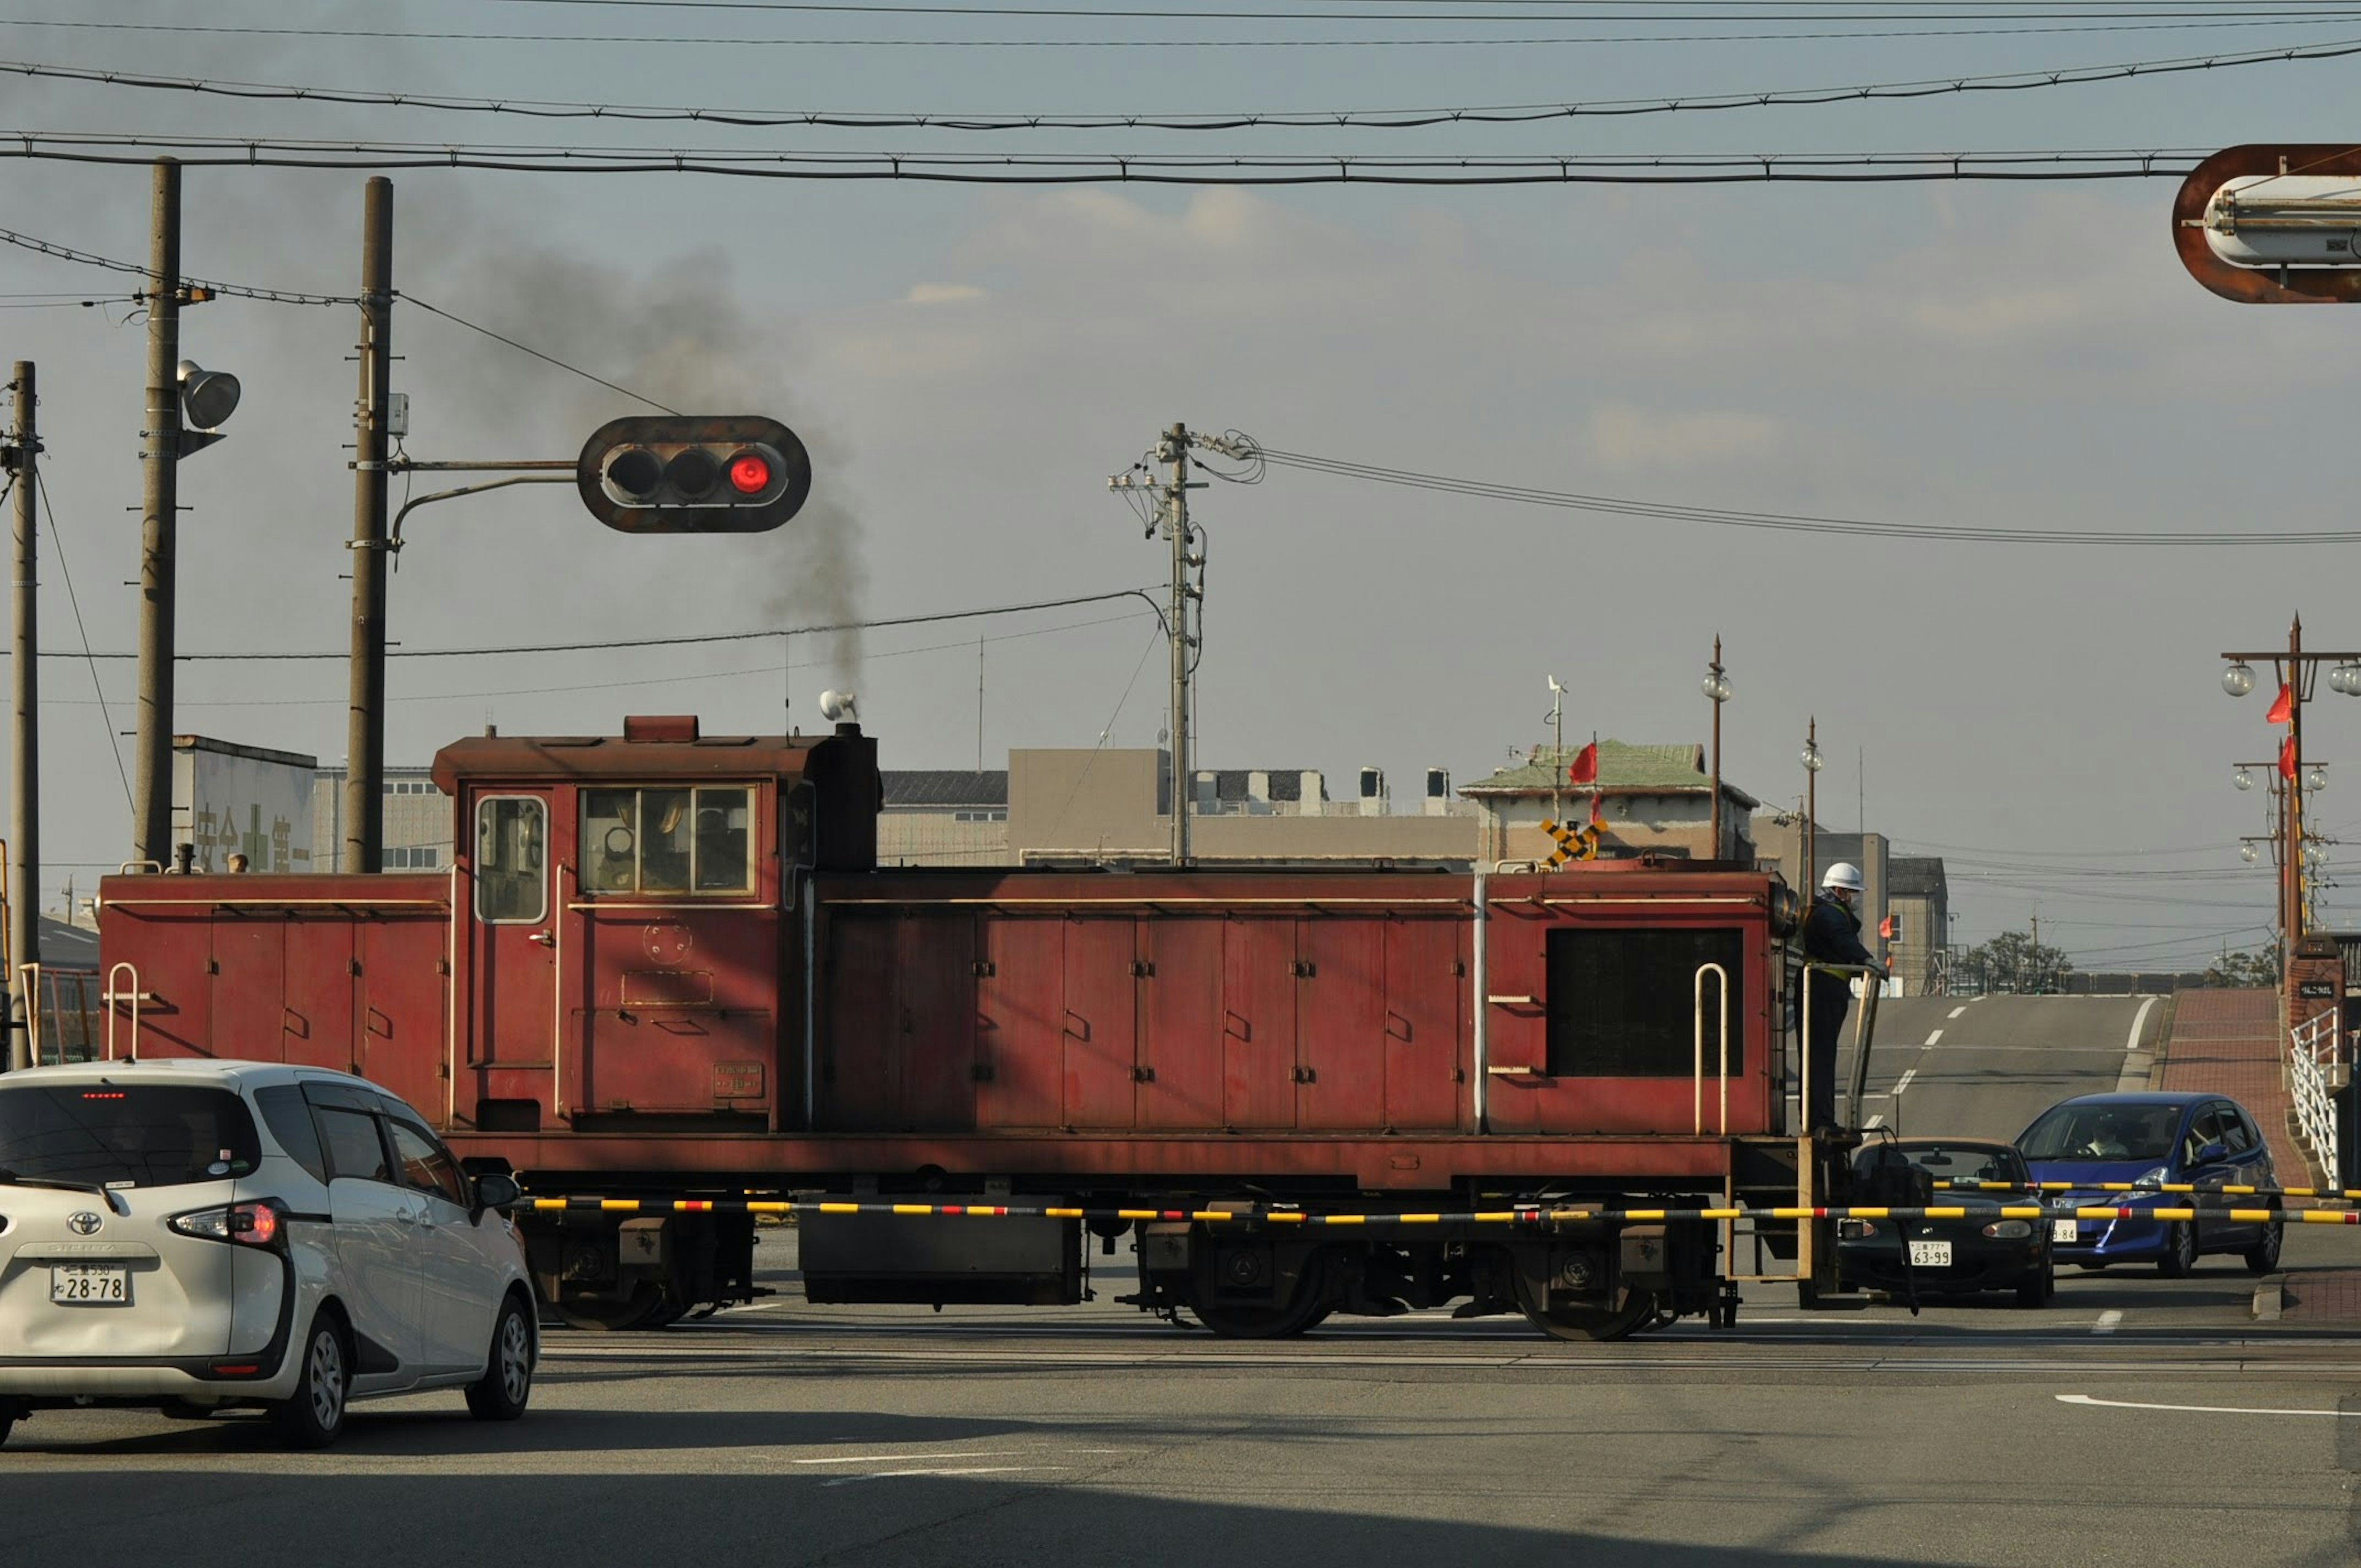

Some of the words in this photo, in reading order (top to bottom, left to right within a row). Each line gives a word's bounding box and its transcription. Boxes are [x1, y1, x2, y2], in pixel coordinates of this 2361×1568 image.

[1914, 1251, 1949, 1264] 63-99
[91, 1264, 110, 1276] 530
[67, 1278, 122, 1299] 28-78
